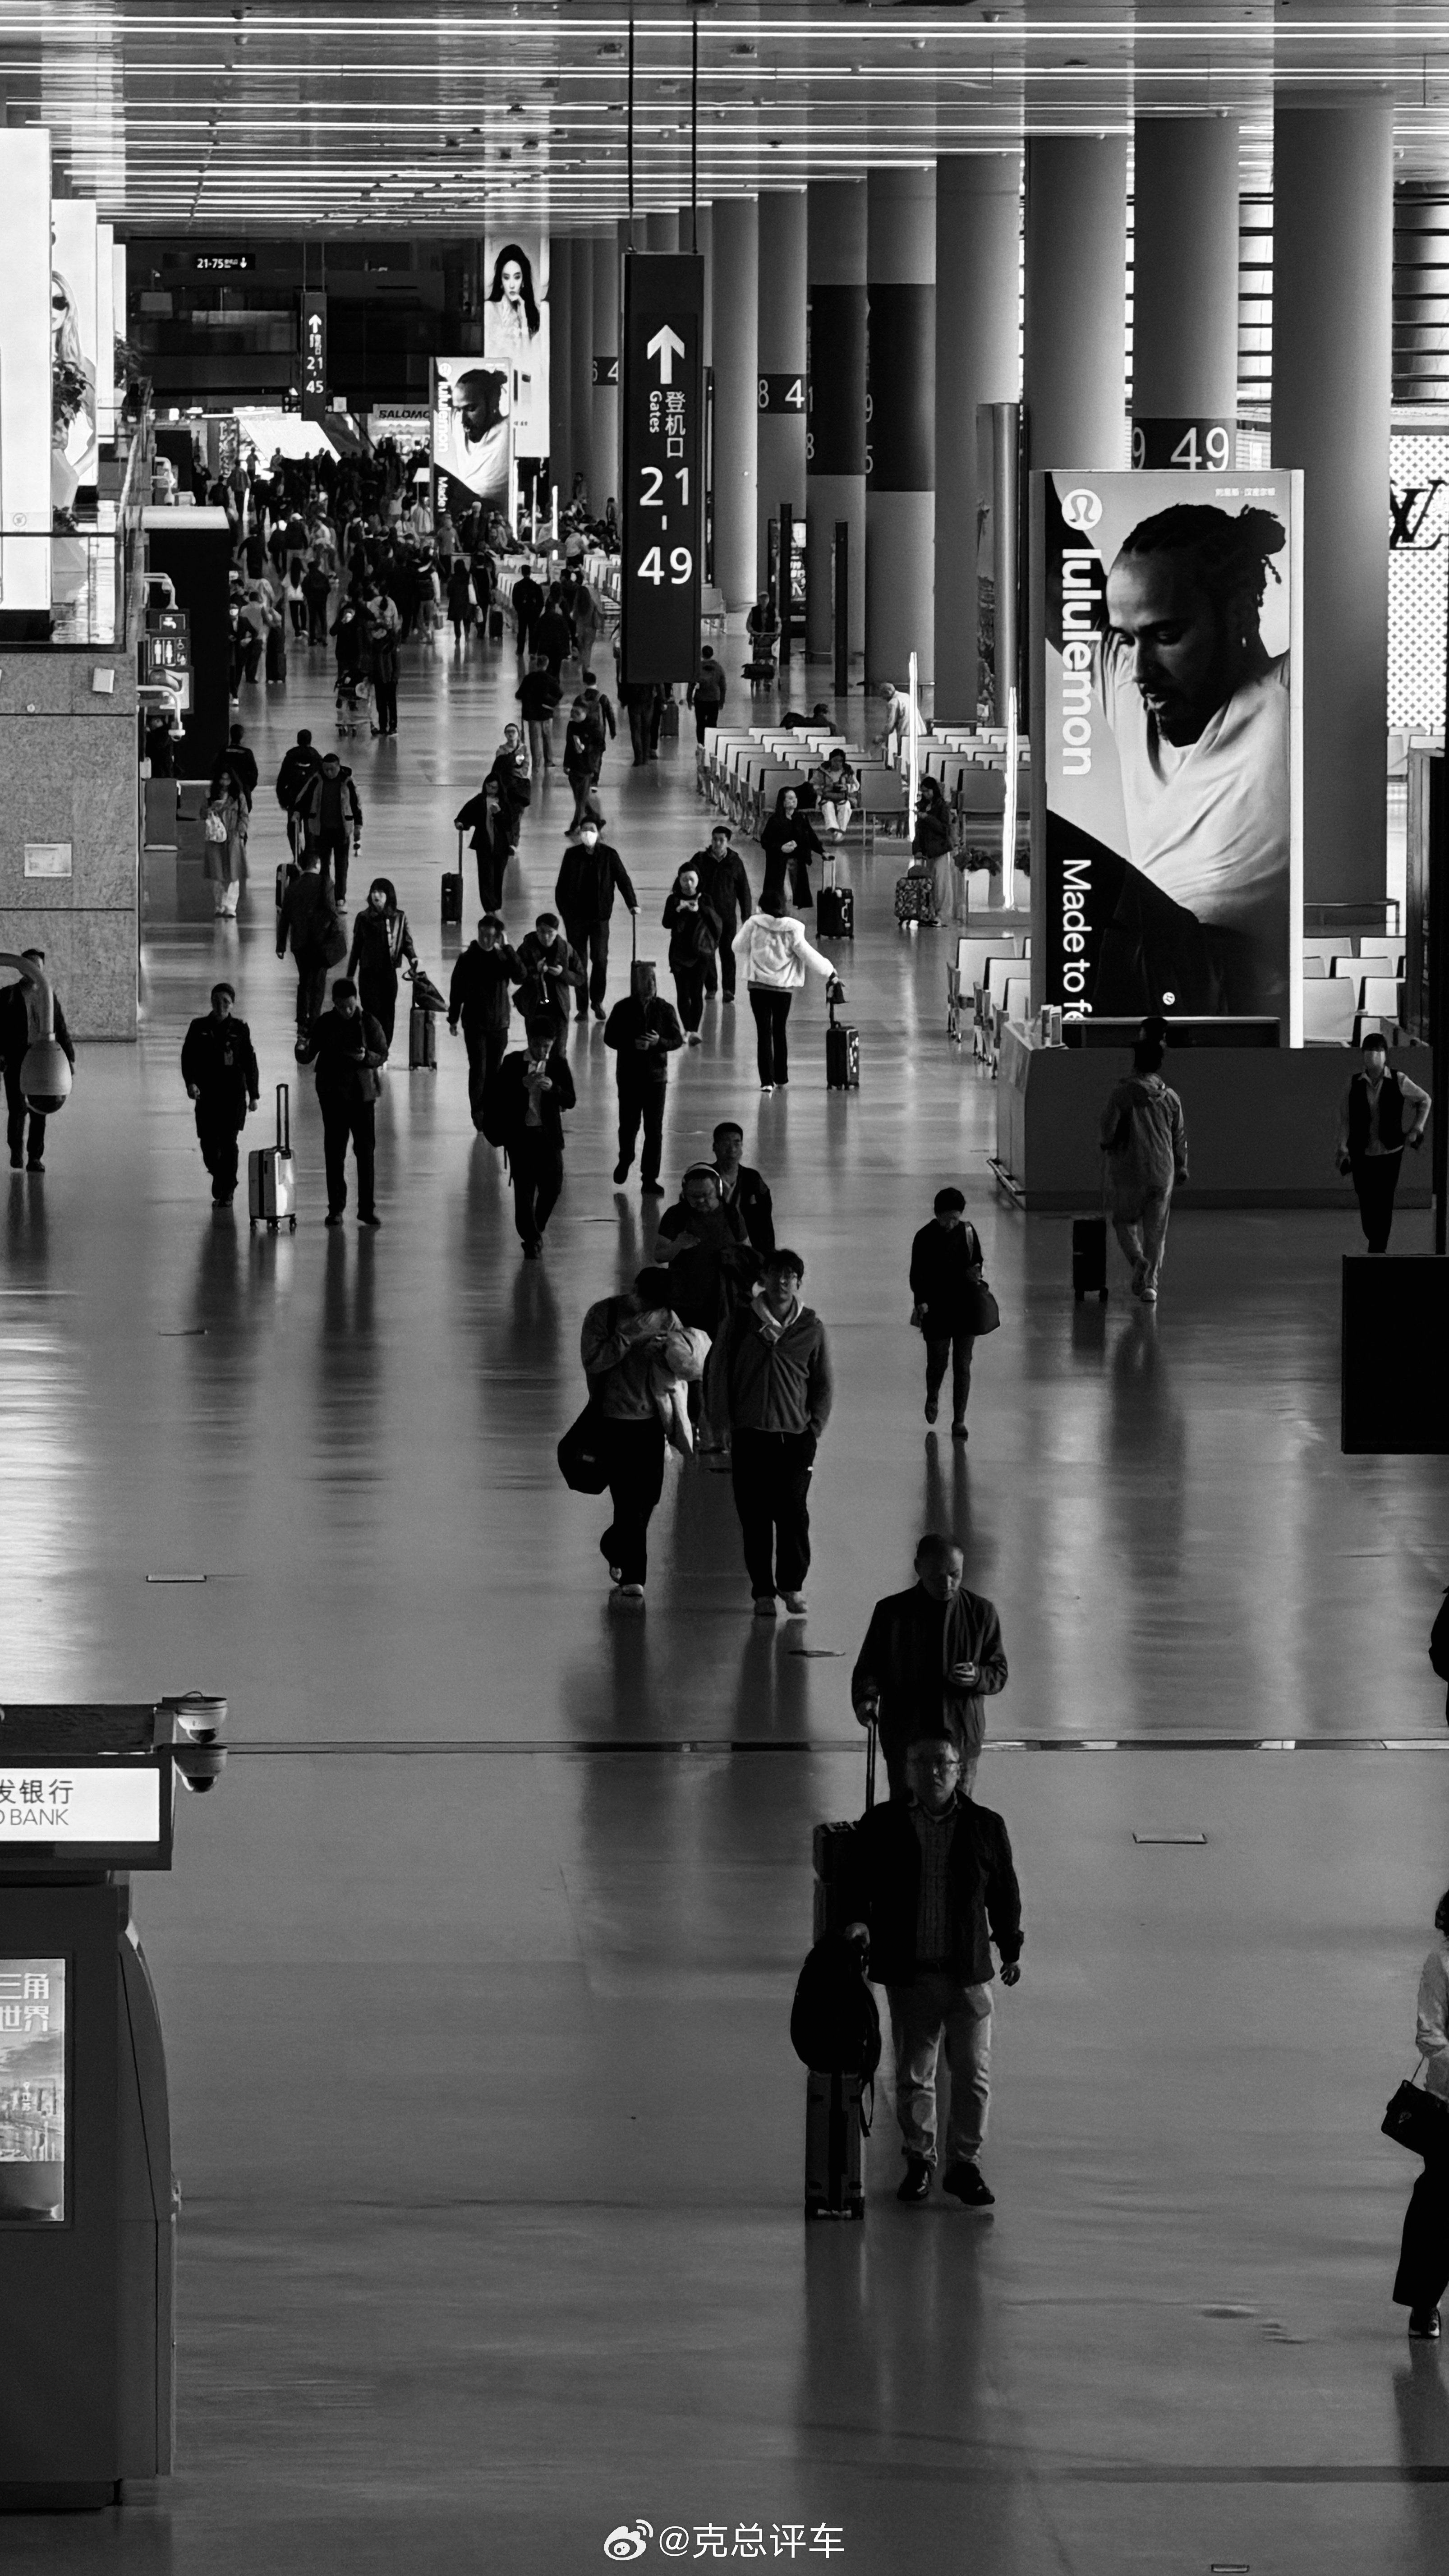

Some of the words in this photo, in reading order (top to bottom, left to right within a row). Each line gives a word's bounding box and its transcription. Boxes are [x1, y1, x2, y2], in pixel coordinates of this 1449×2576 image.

[307, 357, 323, 370] 21
[306, 380, 324, 393] 45
[438, 381, 451, 452] lululemon
[649, 391, 662, 433] Gates
[665, 391, 686, 458] 登机口
[1170, 427, 1229, 470] 49
[639, 467, 689, 506] 21
[637, 547, 692, 585] 49
[1062, 549, 1102, 775] lululemon
[1063, 860, 1092, 952] Made
[1063, 958, 1090, 993] to
[10, 1808, 69, 1826] BANK
